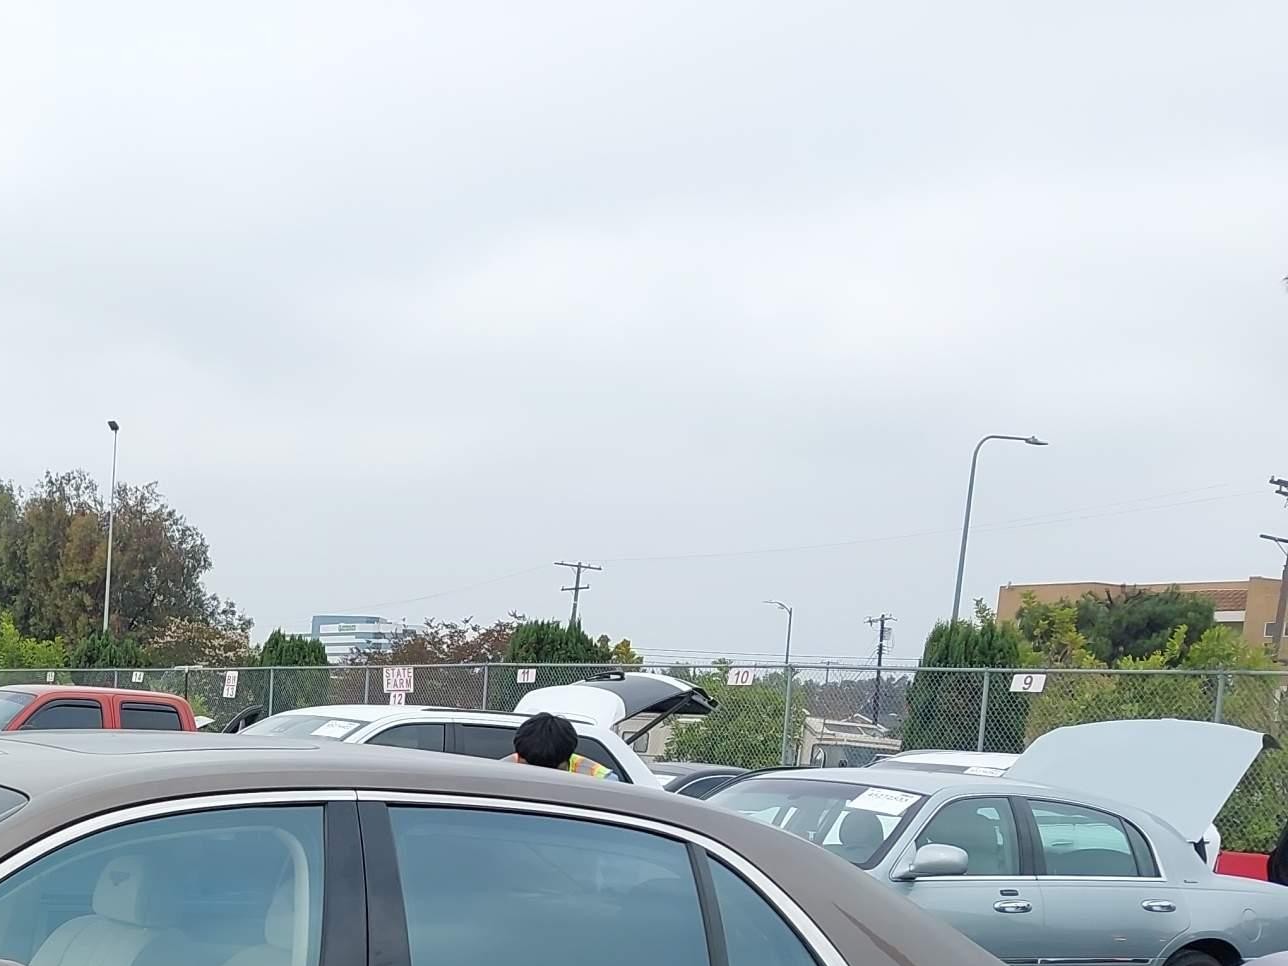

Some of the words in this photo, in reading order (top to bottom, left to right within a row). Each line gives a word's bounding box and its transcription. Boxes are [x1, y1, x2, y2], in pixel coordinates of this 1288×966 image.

[385, 668, 412, 678] STATE
[522, 670, 530, 682] 11
[734, 670, 749, 684] 10
[386, 678, 412, 689] FARM
[1022, 675, 1033, 690] 9
[393, 693, 403, 705] 12
